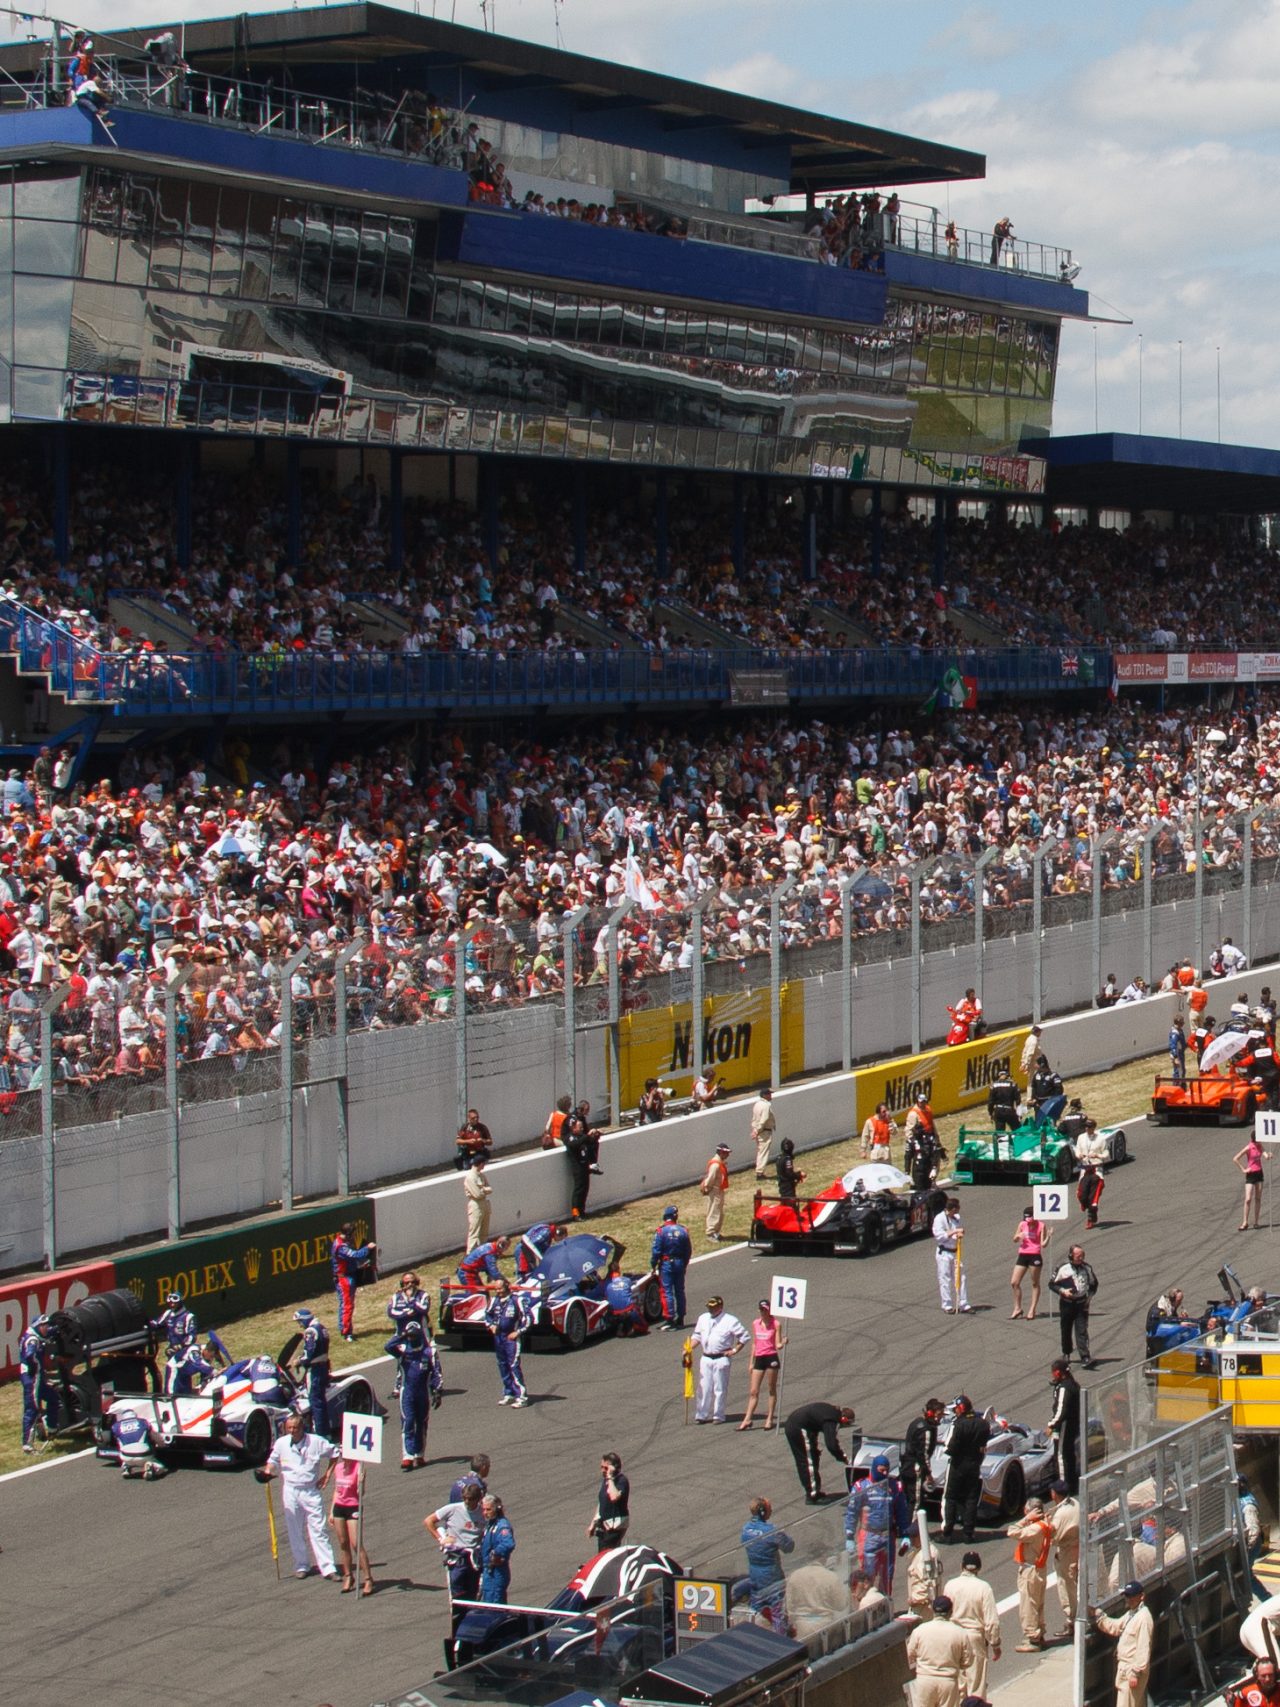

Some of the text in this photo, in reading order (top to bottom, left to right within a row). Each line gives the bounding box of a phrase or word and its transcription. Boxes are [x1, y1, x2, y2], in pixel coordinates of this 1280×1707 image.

[1117, 663, 1166, 675] Audi TDI Power
[1191, 662, 1236, 674] Audi TDI Power
[965, 1053, 1011, 1091] Nikon
[885, 1074, 933, 1112] Nikon
[1263, 1119, 1277, 1136] 11
[1039, 1194, 1062, 1213] 12
[156, 1260, 236, 1307] ROLEX
[776, 1286, 798, 1309] 13
[1222, 1358, 1236, 1371] 78
[350, 1424, 374, 1452] 14
[682, 1584, 716, 1611] 92
